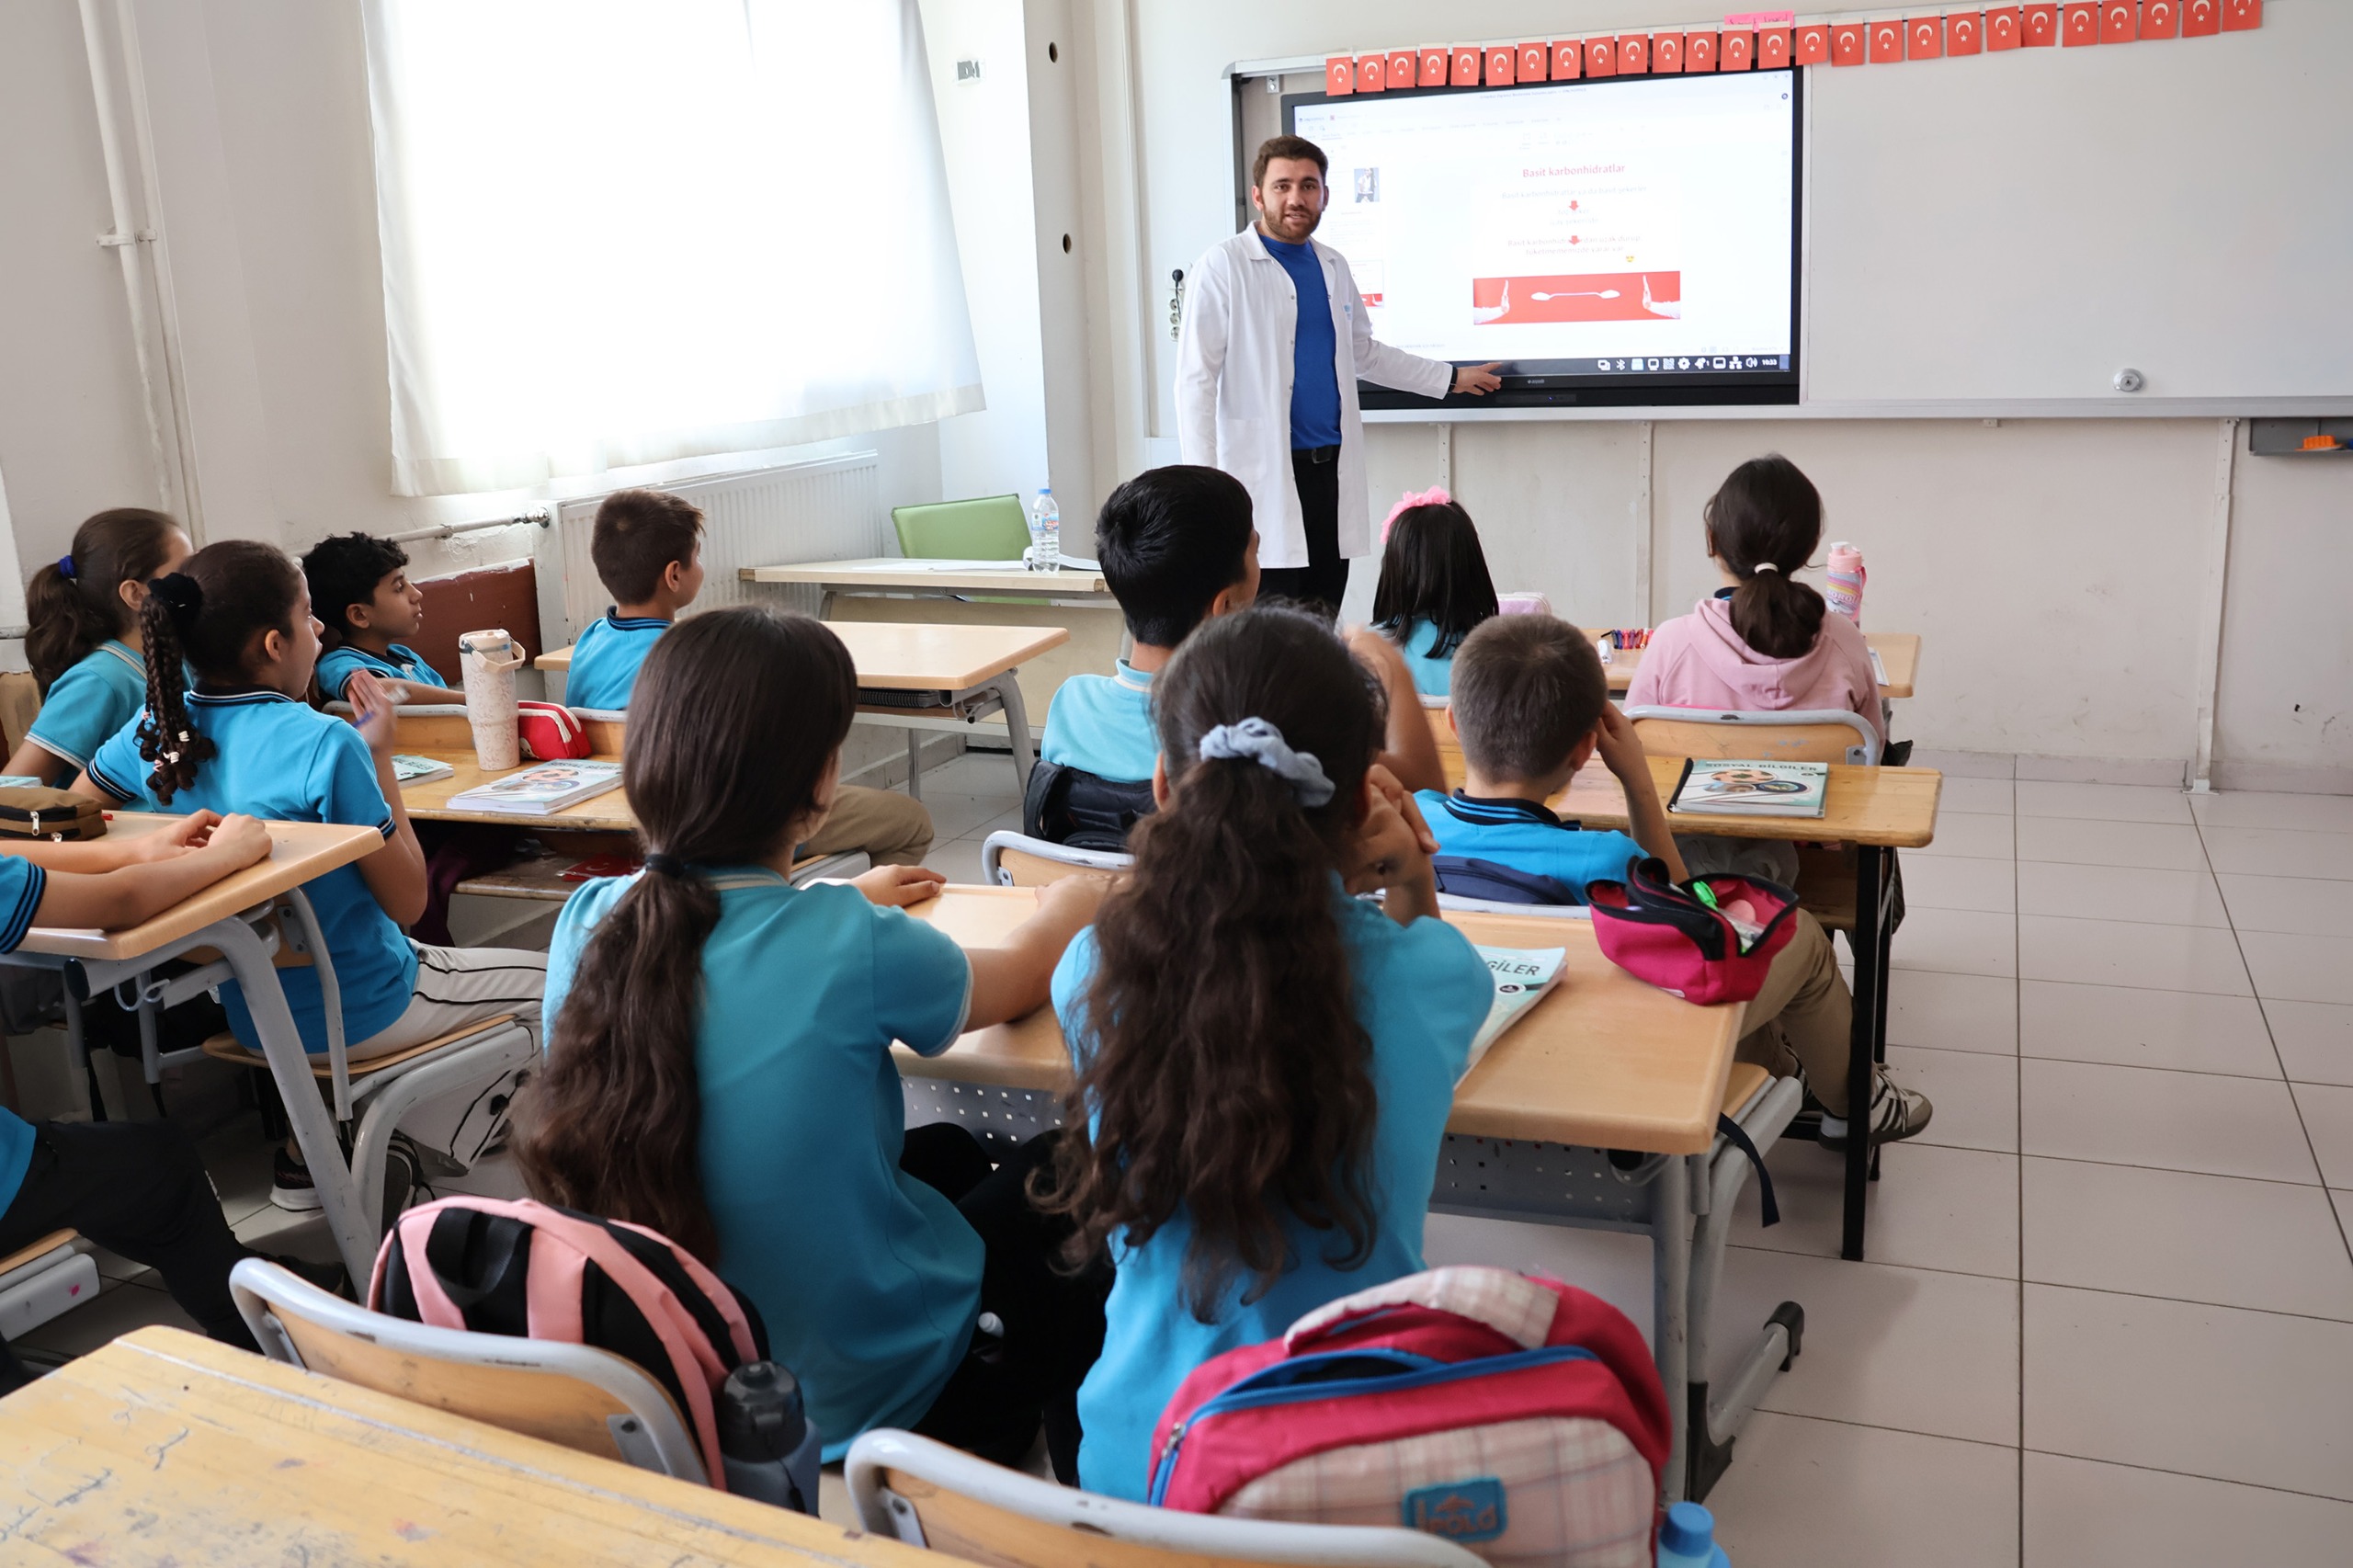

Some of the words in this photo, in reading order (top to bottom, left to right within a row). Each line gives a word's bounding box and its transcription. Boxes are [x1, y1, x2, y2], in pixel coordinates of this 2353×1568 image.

[1522, 166, 1546, 178] Basit
[1549, 164, 1626, 176] karbonhidratlar
[1501, 191, 1518, 200] Basit
[1520, 187, 1576, 199] karbonhidratlar
[1598, 186, 1616, 195] basit
[1486, 960, 1540, 976] GİLER
